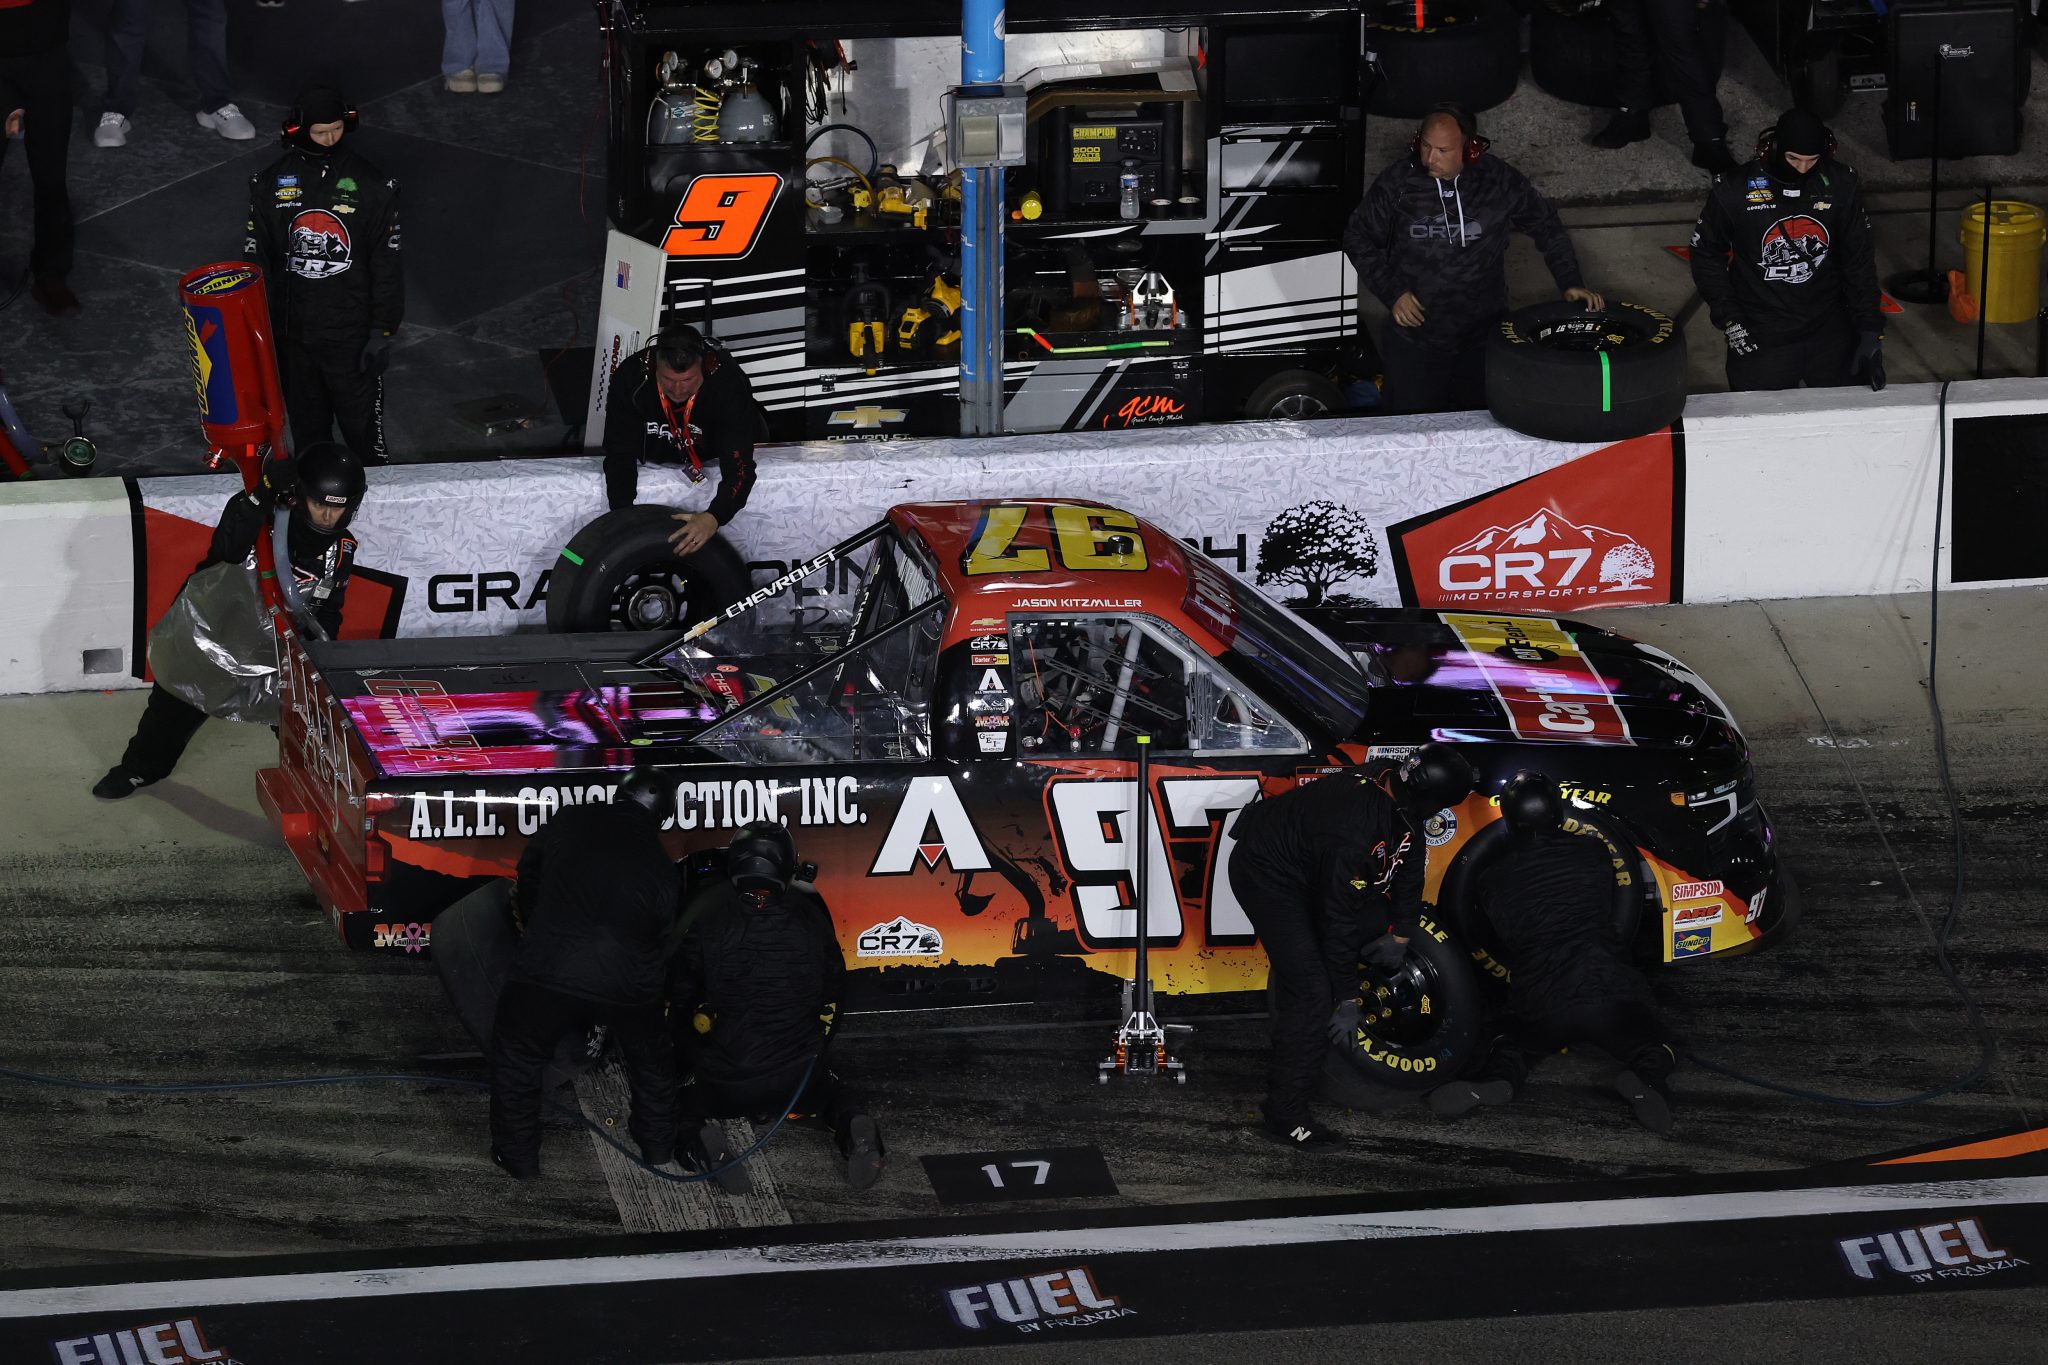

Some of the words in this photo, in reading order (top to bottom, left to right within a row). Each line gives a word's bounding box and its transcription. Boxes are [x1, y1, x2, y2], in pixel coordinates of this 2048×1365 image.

[1073, 127, 1117, 138] CHAMPION
[661, 173, 780, 256] 9
[1409, 223, 1461, 240] CR7
[1438, 547, 1593, 591] CR7
[726, 549, 836, 619] CHEVROLET
[1453, 585, 1598, 601] MOTORSPORTS
[1012, 598, 1057, 608] JASON
[1060, 598, 1142, 608] KITZMILLER
[970, 641, 998, 649] CR7
[1524, 669, 1596, 733] Carter
[373, 697, 422, 747] MINING
[410, 787, 505, 839] A.L.L.
[800, 775, 868, 826] INC.
[1047, 775, 1268, 948] 97
[1674, 882, 1721, 900] SIMPSON
[1745, 884, 1768, 925] 97
[1674, 904, 1721, 921] ARP
[859, 935, 919, 951] CR7
[1676, 937, 1710, 950] SUNOCO
[981, 1160, 1051, 1188] 17
[1839, 1219, 2007, 1279] FUEL
[1936, 1258, 2031, 1279] FRANZIA
[947, 1268, 1116, 1329] FUEL
[1016, 1322, 1041, 1334] BY
[1046, 1307, 1138, 1328] FRANZIA
[54, 1319, 222, 1365] FUEL
